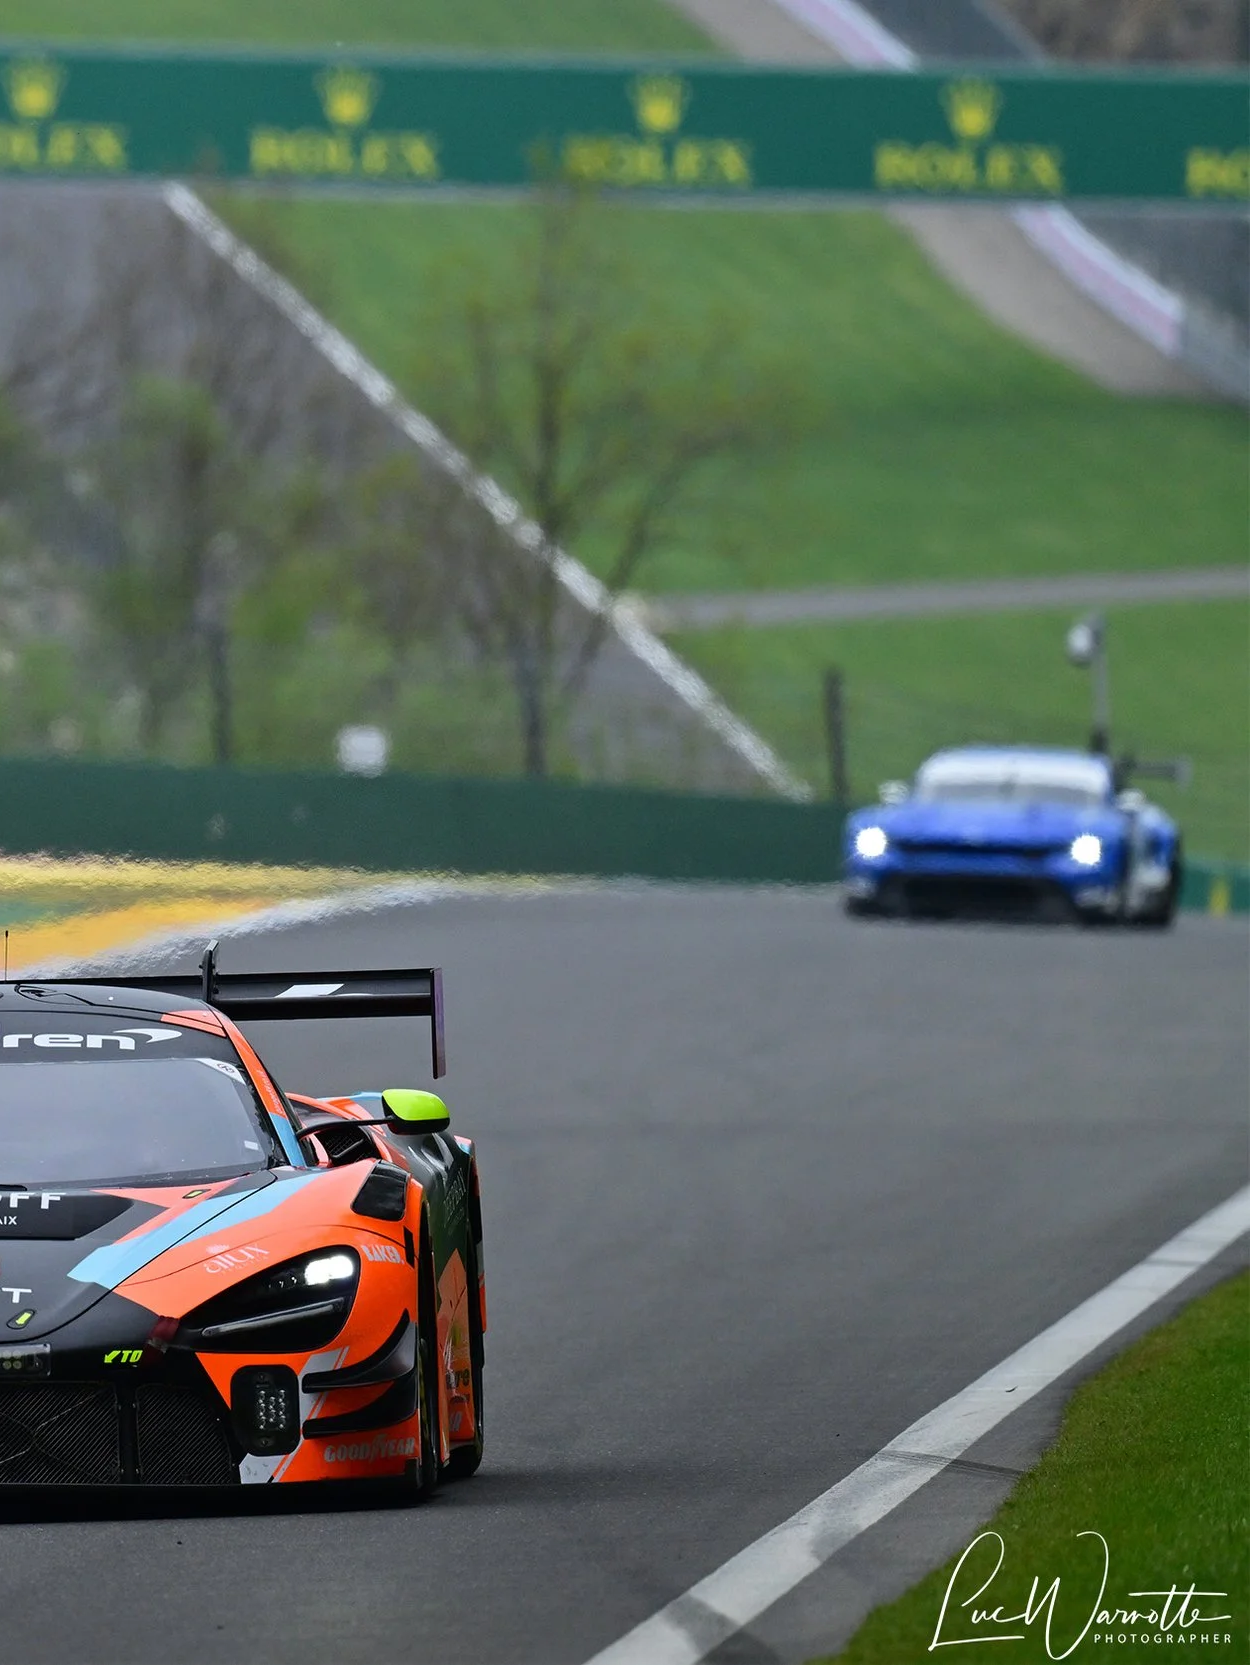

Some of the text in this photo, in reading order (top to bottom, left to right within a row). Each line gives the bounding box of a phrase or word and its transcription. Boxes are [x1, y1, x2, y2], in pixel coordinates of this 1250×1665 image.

[252, 127, 439, 181] ROLEX
[561, 135, 753, 187] ROLEX
[874, 140, 1064, 192] ROLEX
